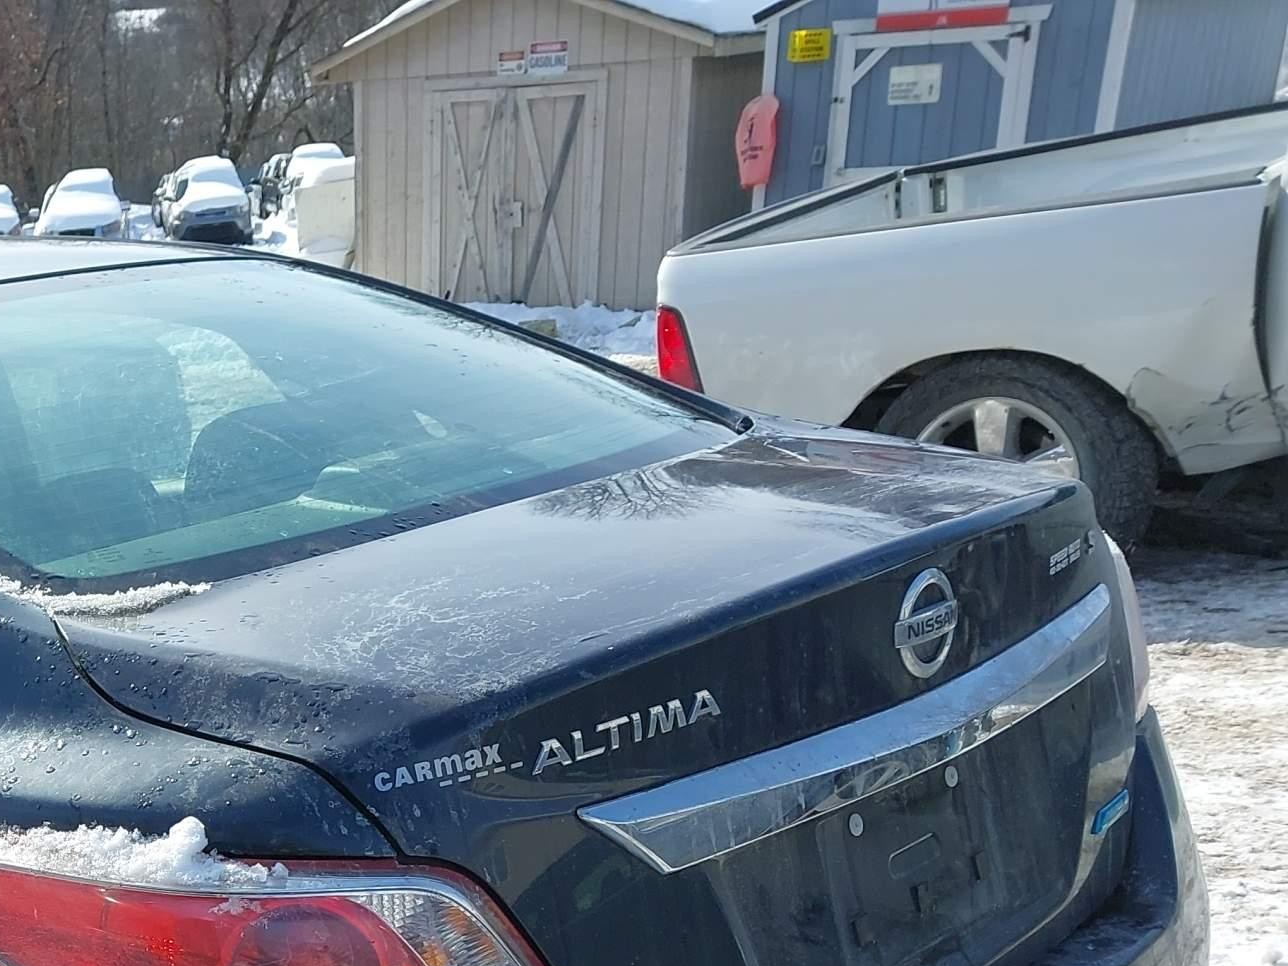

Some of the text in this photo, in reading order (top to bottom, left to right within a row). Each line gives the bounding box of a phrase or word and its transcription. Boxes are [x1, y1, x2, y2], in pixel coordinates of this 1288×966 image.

[529, 54, 567, 69] GASOLINE
[907, 607, 955, 641] NISSAN
[532, 689, 722, 777] ALTIMA
